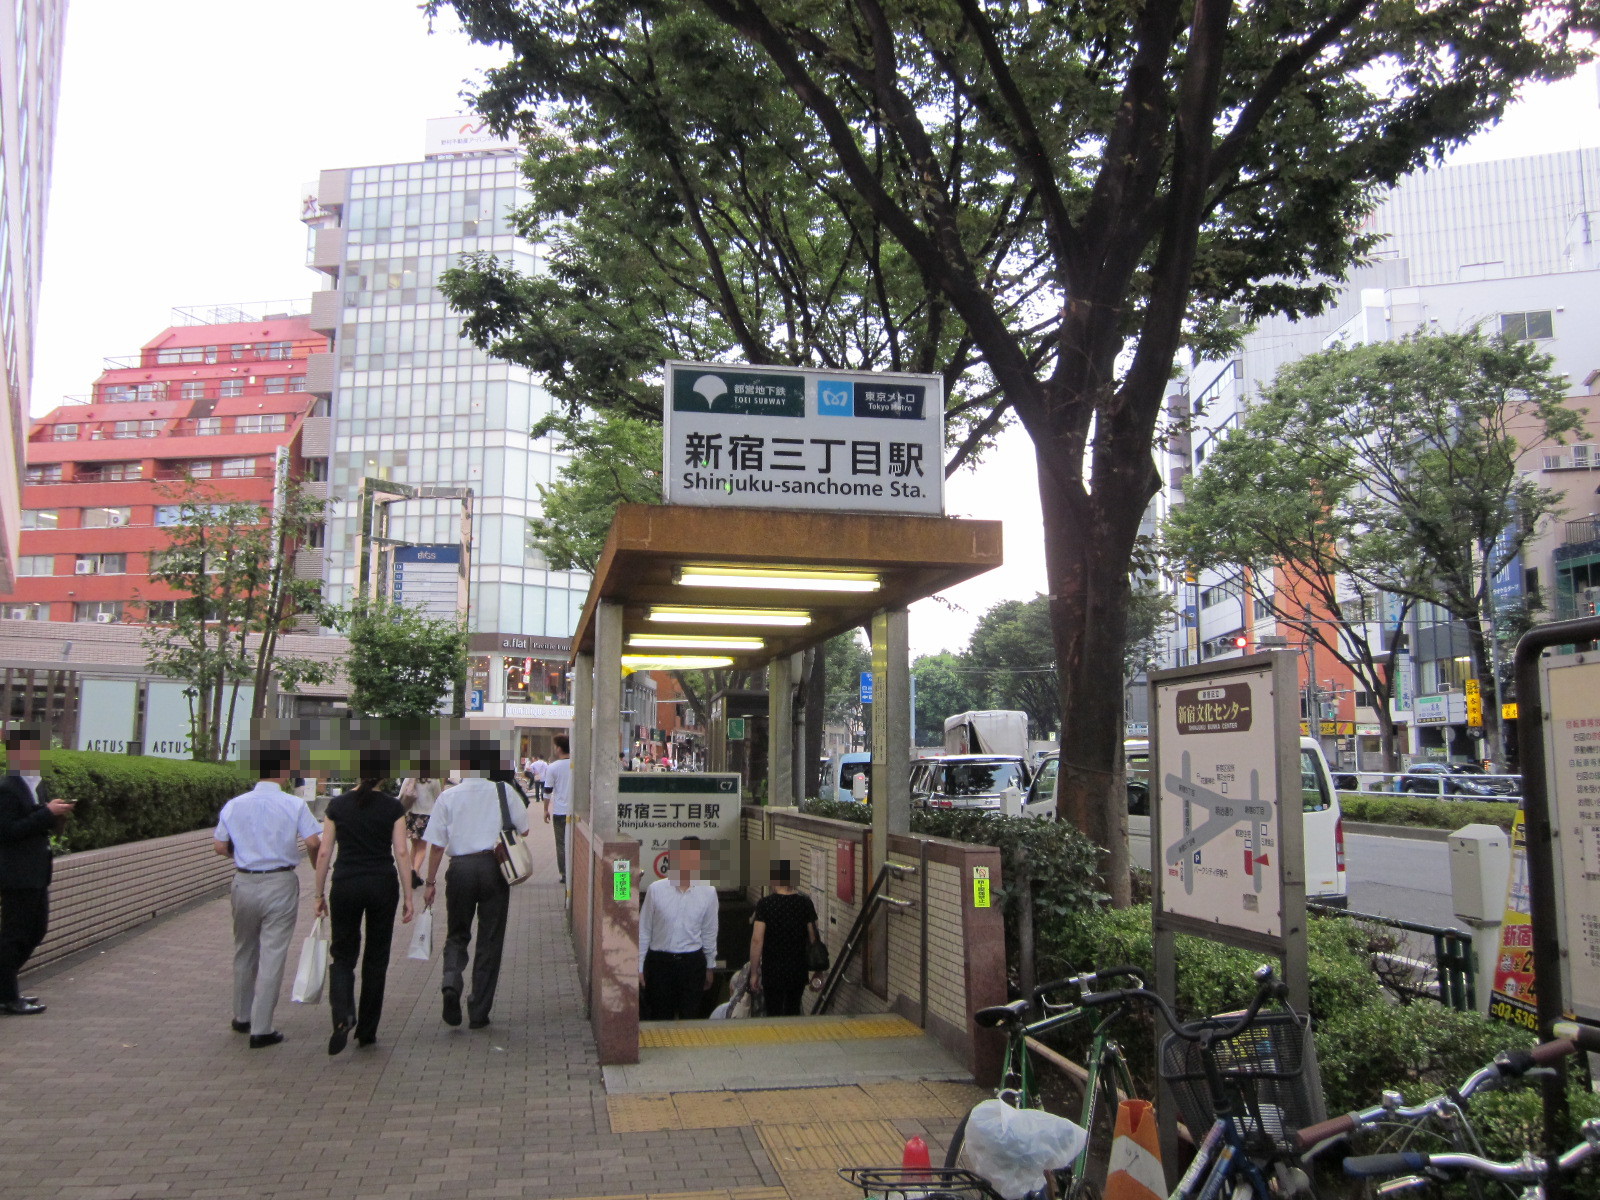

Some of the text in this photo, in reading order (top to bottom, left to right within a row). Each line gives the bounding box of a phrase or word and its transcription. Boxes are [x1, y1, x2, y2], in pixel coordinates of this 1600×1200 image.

[734, 384, 786, 397] 都営地下鉄
[865, 391, 915, 403] 東京メトロ
[734, 396, 786, 406] TOEI SUBWAY
[868, 403, 890, 411] Tokyo
[685, 432, 924, 478] 新宿三丁目駅
[683, 473, 926, 498] Shinjuku-sanchome Sta.
[503, 638, 526, 648] a.flat
[1178, 702, 1249, 723] 新宿文化センター
[87, 740, 188, 754] ACTUS ACTUS
[719, 782, 733, 790] C7
[617, 803, 720, 819] 新宿三丁目駅
[617, 820, 700, 829] Shinjuku-sanchome
[1503, 924, 1533, 947] 新宿
